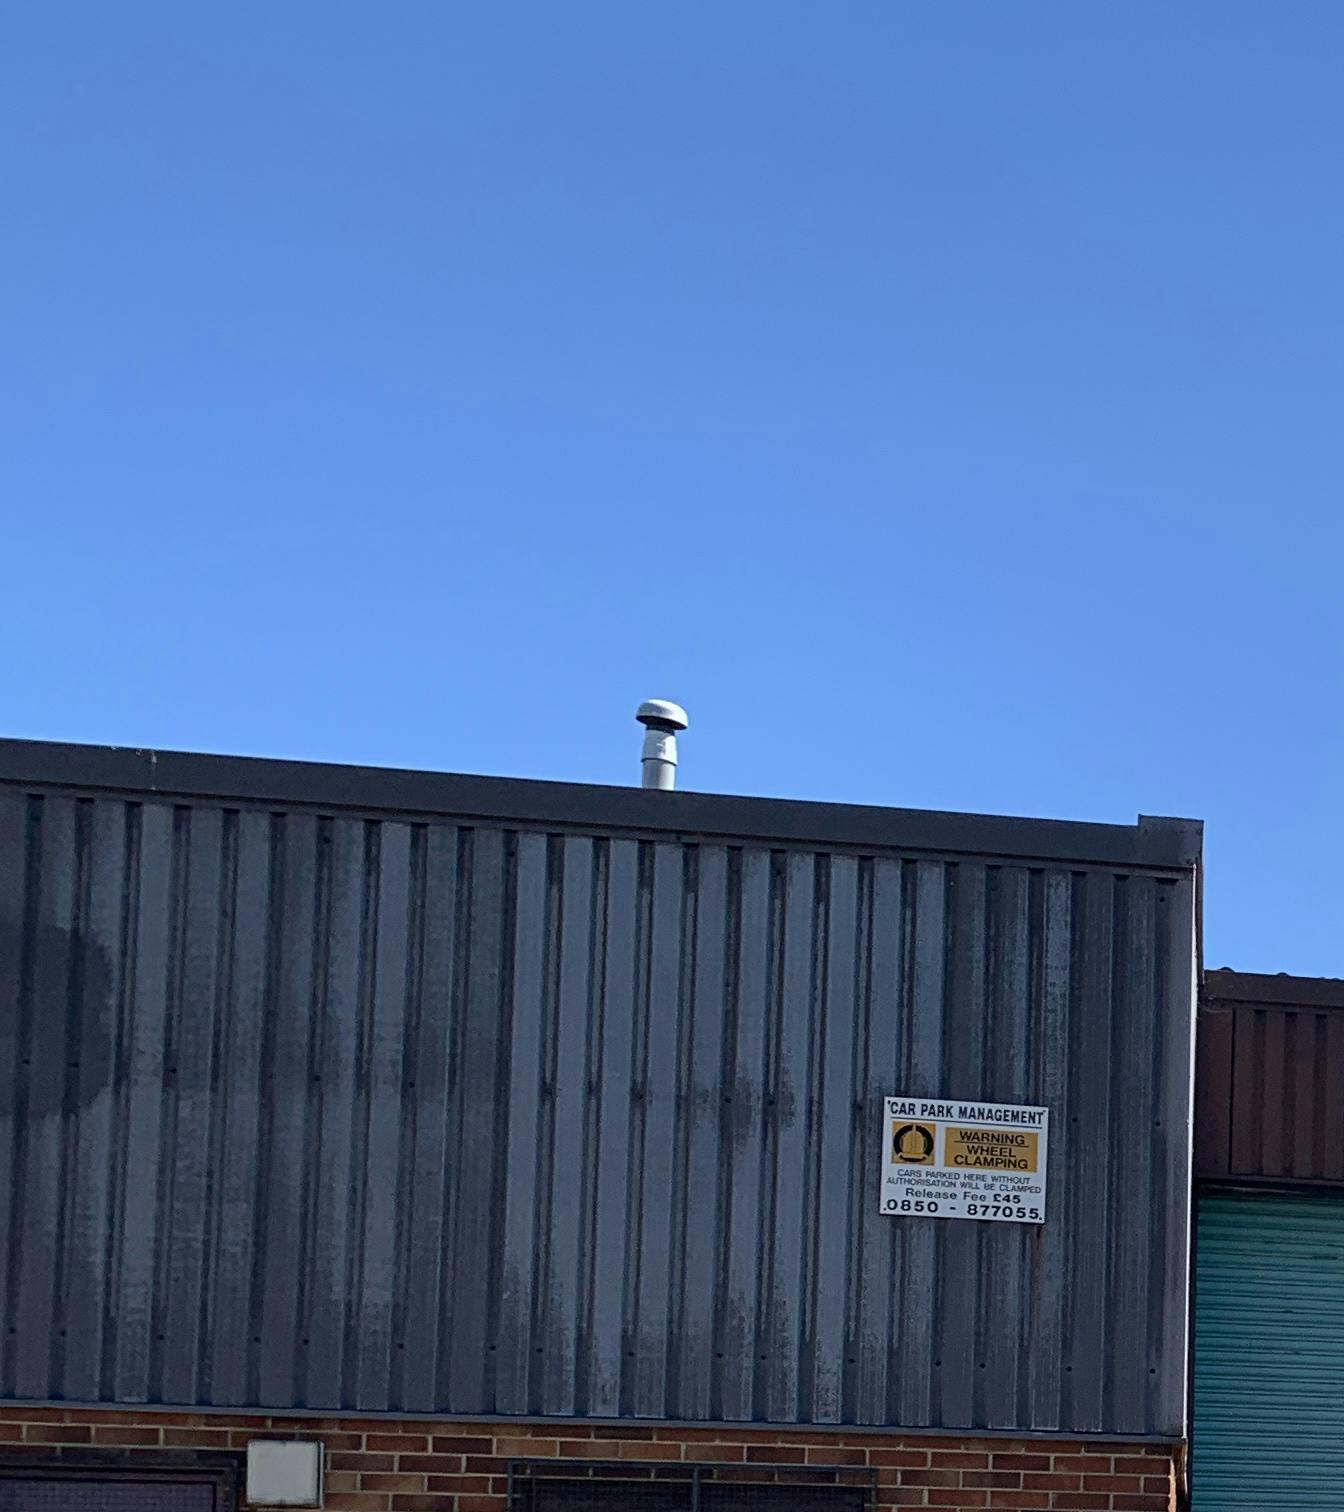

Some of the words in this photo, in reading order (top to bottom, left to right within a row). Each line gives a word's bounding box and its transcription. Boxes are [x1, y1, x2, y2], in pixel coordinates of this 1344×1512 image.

[890, 1102, 916, 1115] CAR
[921, 1103, 954, 1118] PARK
[958, 1106, 1043, 1124] MANAGEMENT
[960, 1130, 1025, 1145] WARNING
[967, 1145, 1016, 1158] WHEEL
[954, 1154, 1028, 1169] CLAMPING
[897, 1168, 922, 1178] CARS
[926, 1170, 960, 1180] PARKED
[964, 1173, 987, 1182] HERE
[991, 1175, 1031, 1185] WITHOUT
[886, 1176, 956, 1188] AUTHORISATION
[960, 1181, 980, 1190] WILL
[984, 1183, 995, 1191] BE
[1000, 1184, 1042, 1194] CLAMPED
[905, 1187, 957, 1200] Release
[963, 1191, 987, 1202] Fee
[993, 1193, 1021, 1203] £45
